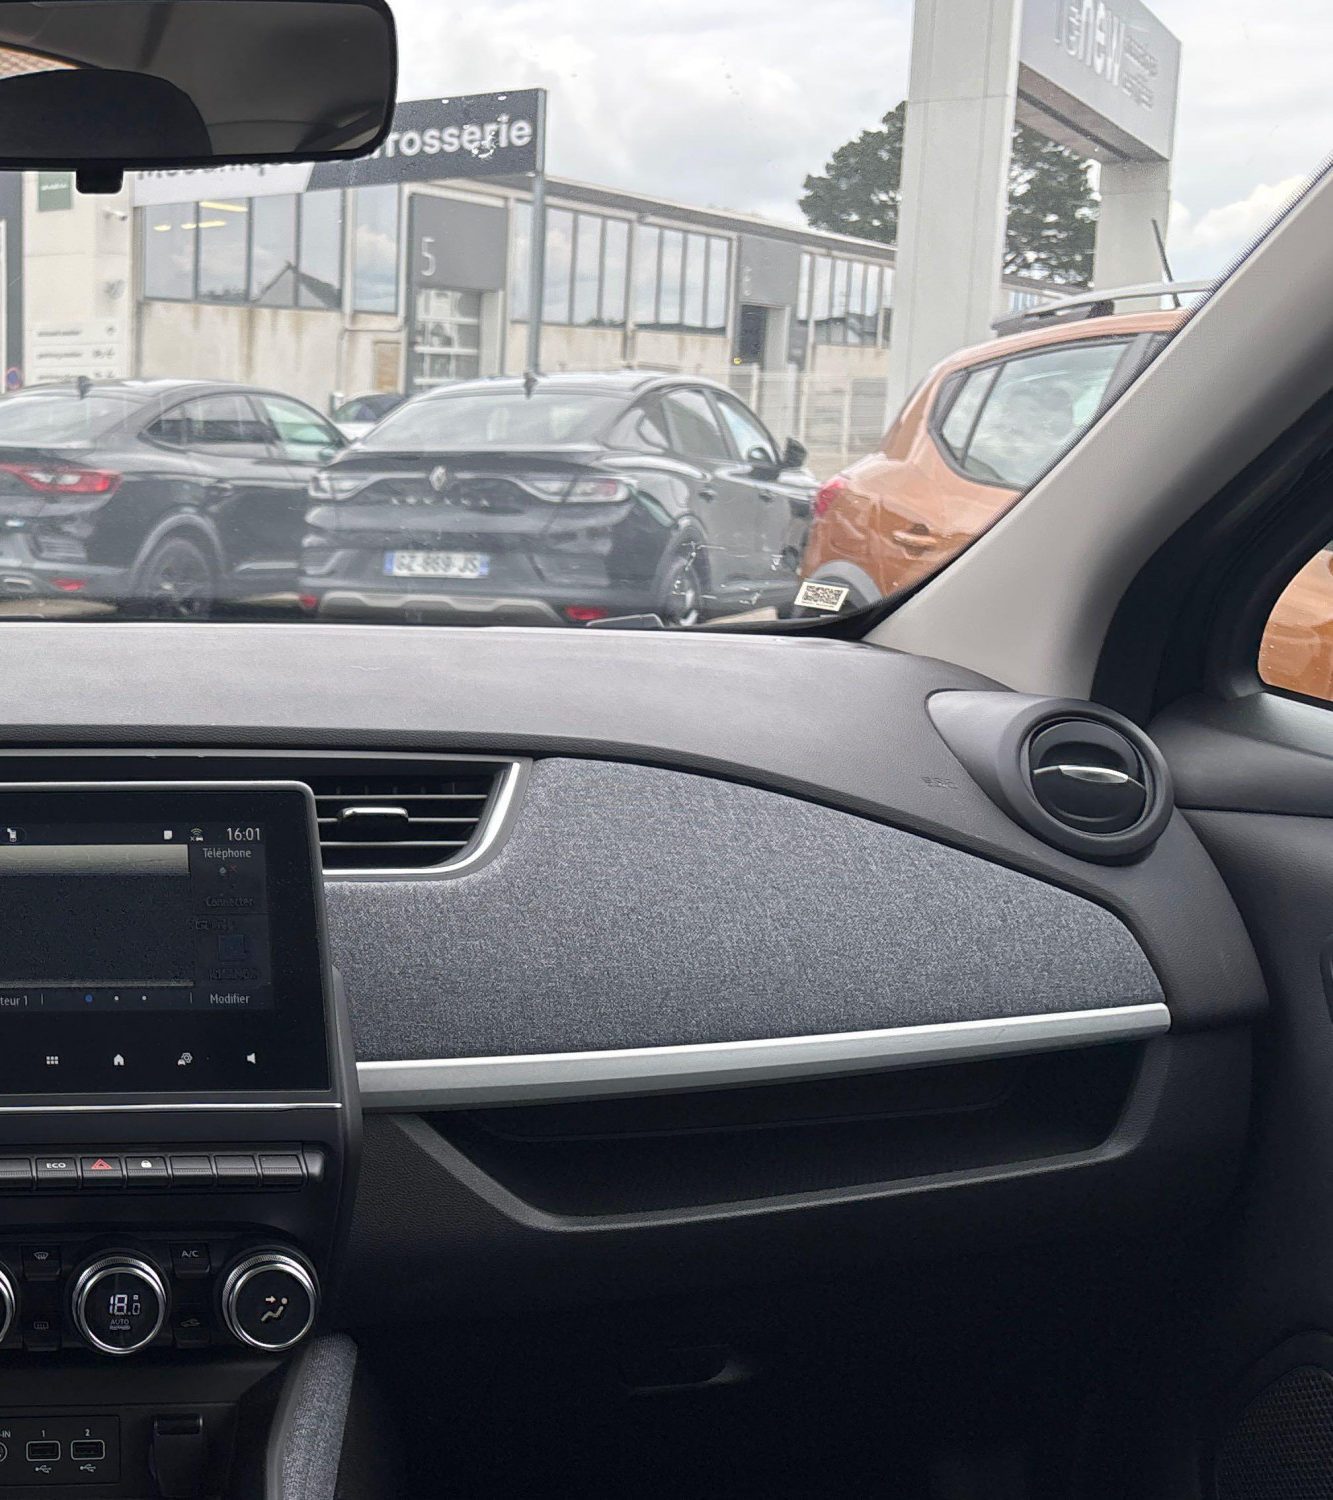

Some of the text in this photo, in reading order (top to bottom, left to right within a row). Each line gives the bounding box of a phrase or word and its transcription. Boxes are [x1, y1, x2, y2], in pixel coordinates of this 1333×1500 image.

[420, 236, 436, 277] 5
[226, 827, 261, 841] 16:01
[202, 847, 252, 860] Téléphone
[23, 995, 28, 1006] 1
[209, 993, 251, 1004] Modifier
[181, 1250, 200, 1258] A/C
[41, 1429, 46, 1438] 1
[85, 1429, 91, 1437] 2
